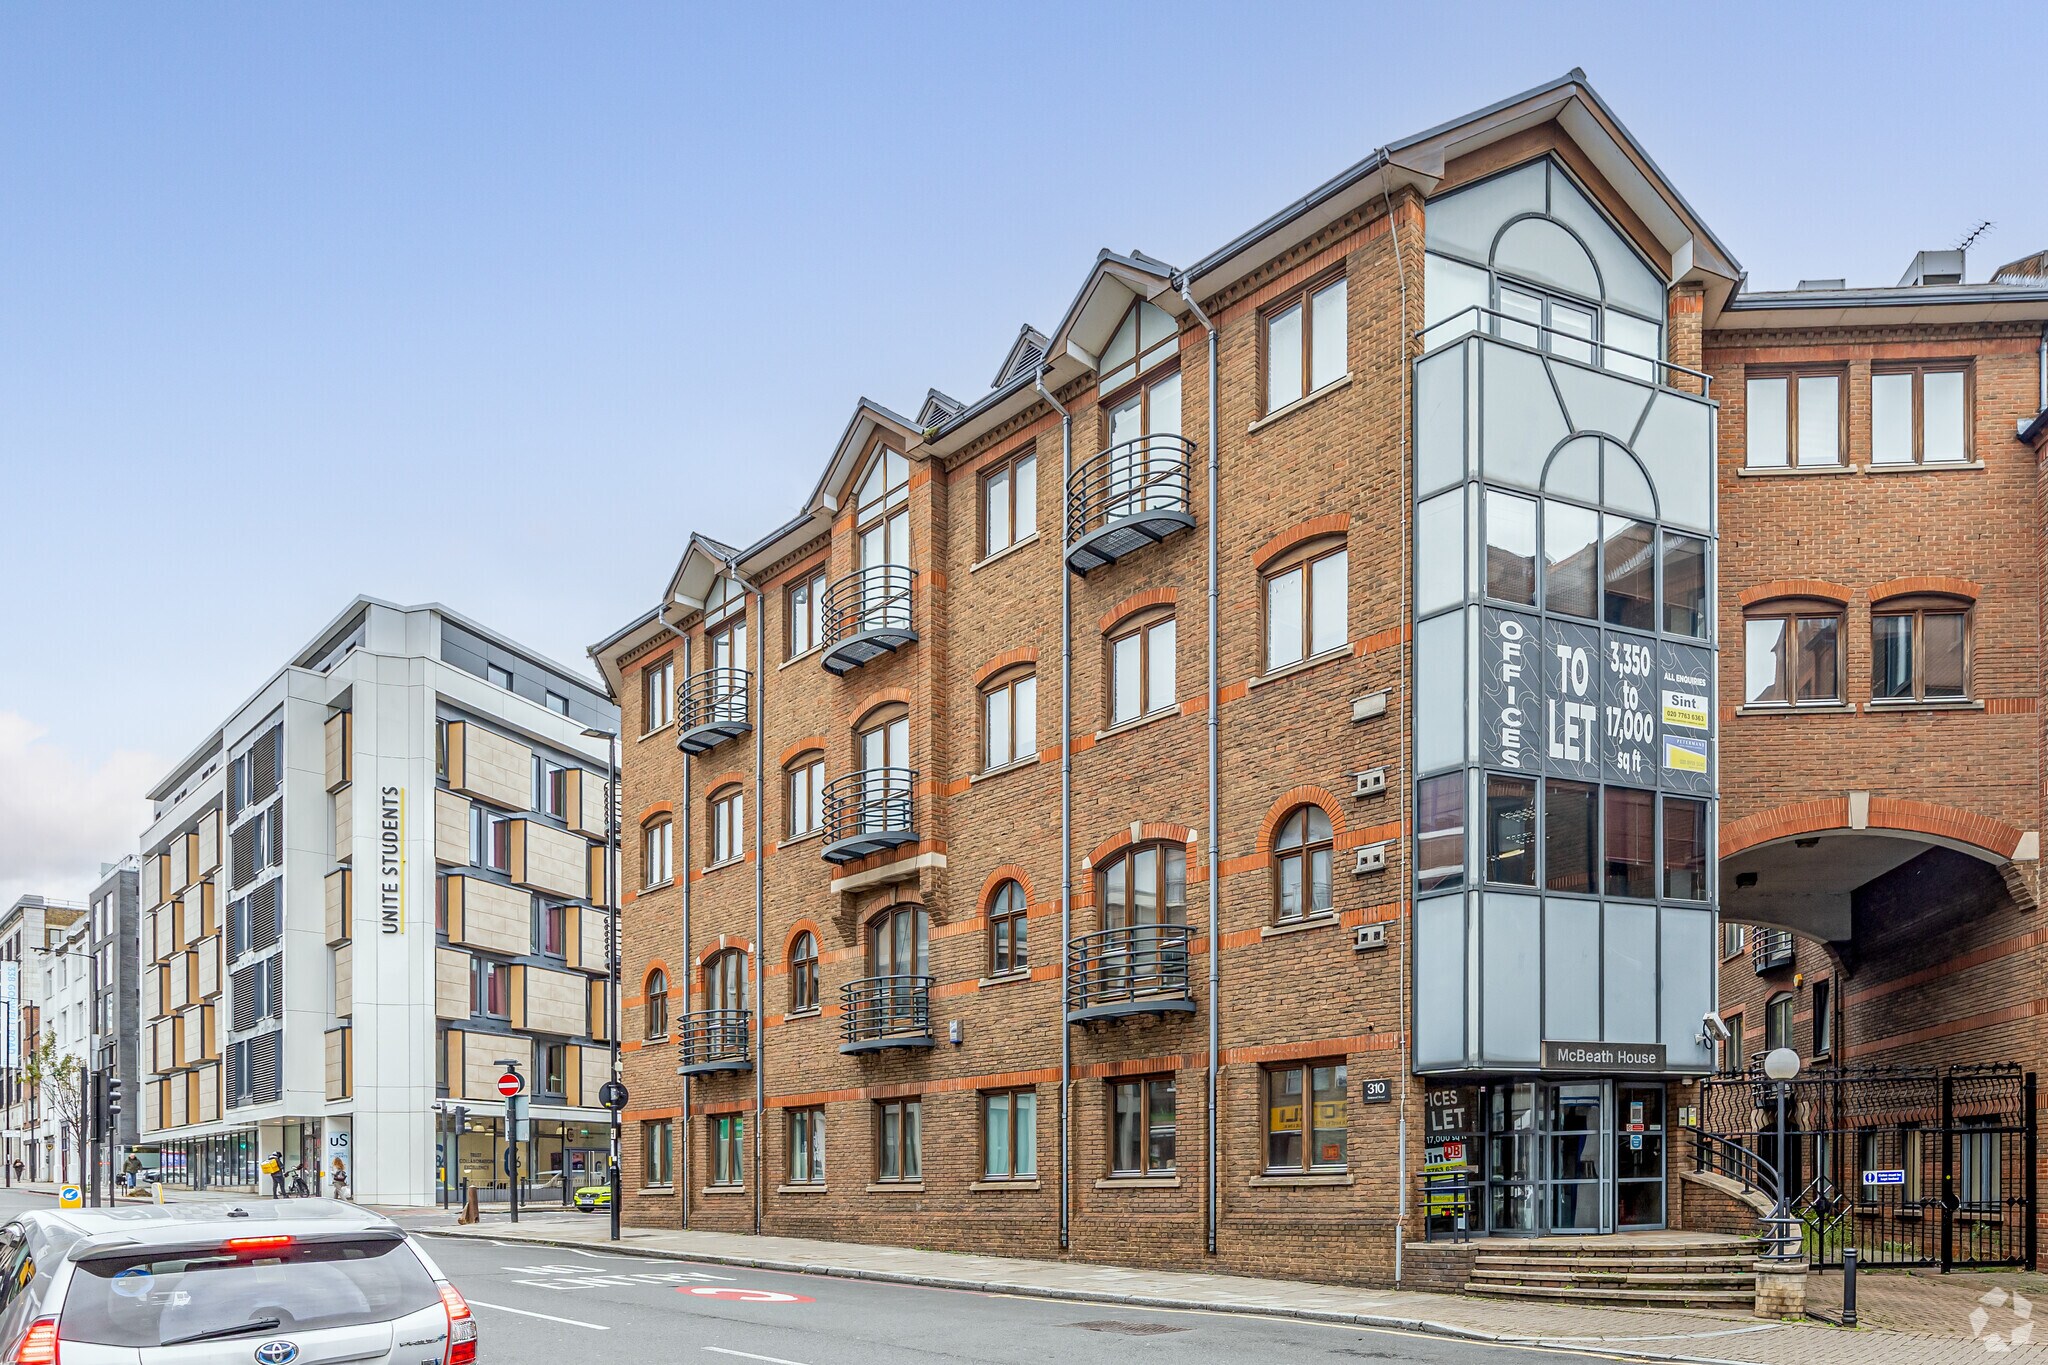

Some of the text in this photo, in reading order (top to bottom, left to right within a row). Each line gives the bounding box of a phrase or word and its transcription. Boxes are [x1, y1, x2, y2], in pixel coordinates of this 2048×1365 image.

[1557, 645, 1589, 697] TO
[1610, 641, 1650, 678] 3,350
[1664, 672, 1706, 687] ALL ENQUIRIES
[1499, 620, 1524, 769] OFFICES
[1623, 680, 1638, 711] to
[1606, 705, 1653, 744] 17,000
[1667, 710, 1677, 718] 020
[1550, 699, 1596, 763] LET
[1617, 749, 1641, 774] sq ft
[382, 786, 399, 934] UNITE STUDENTS
[1557, 1048, 1656, 1064] McBeath House
[1367, 1082, 1385, 1094] 310
[1431, 1108, 1465, 1131] LET
[502, 1264, 607, 1275] NO
[512, 1272, 737, 1290] ENTRY
